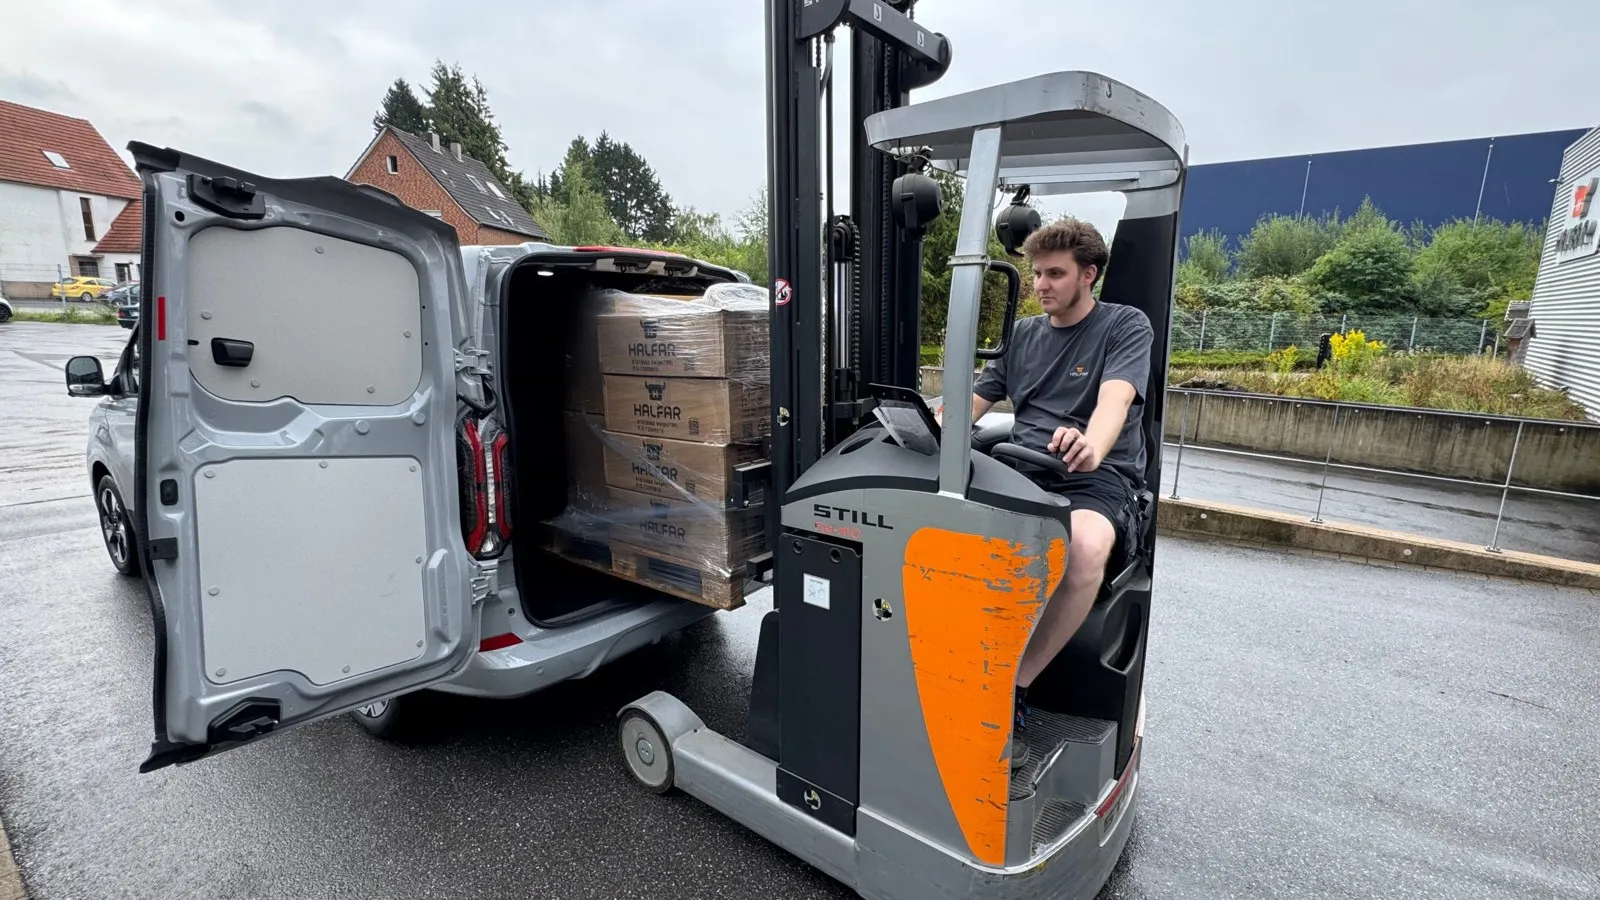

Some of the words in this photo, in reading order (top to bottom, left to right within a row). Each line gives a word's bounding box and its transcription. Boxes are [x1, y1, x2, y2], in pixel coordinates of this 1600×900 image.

[628, 343, 676, 357] HALFAR
[633, 403, 682, 421] HALFAR
[814, 504, 894, 530] STILL
[640, 521, 686, 541] HALFAR
